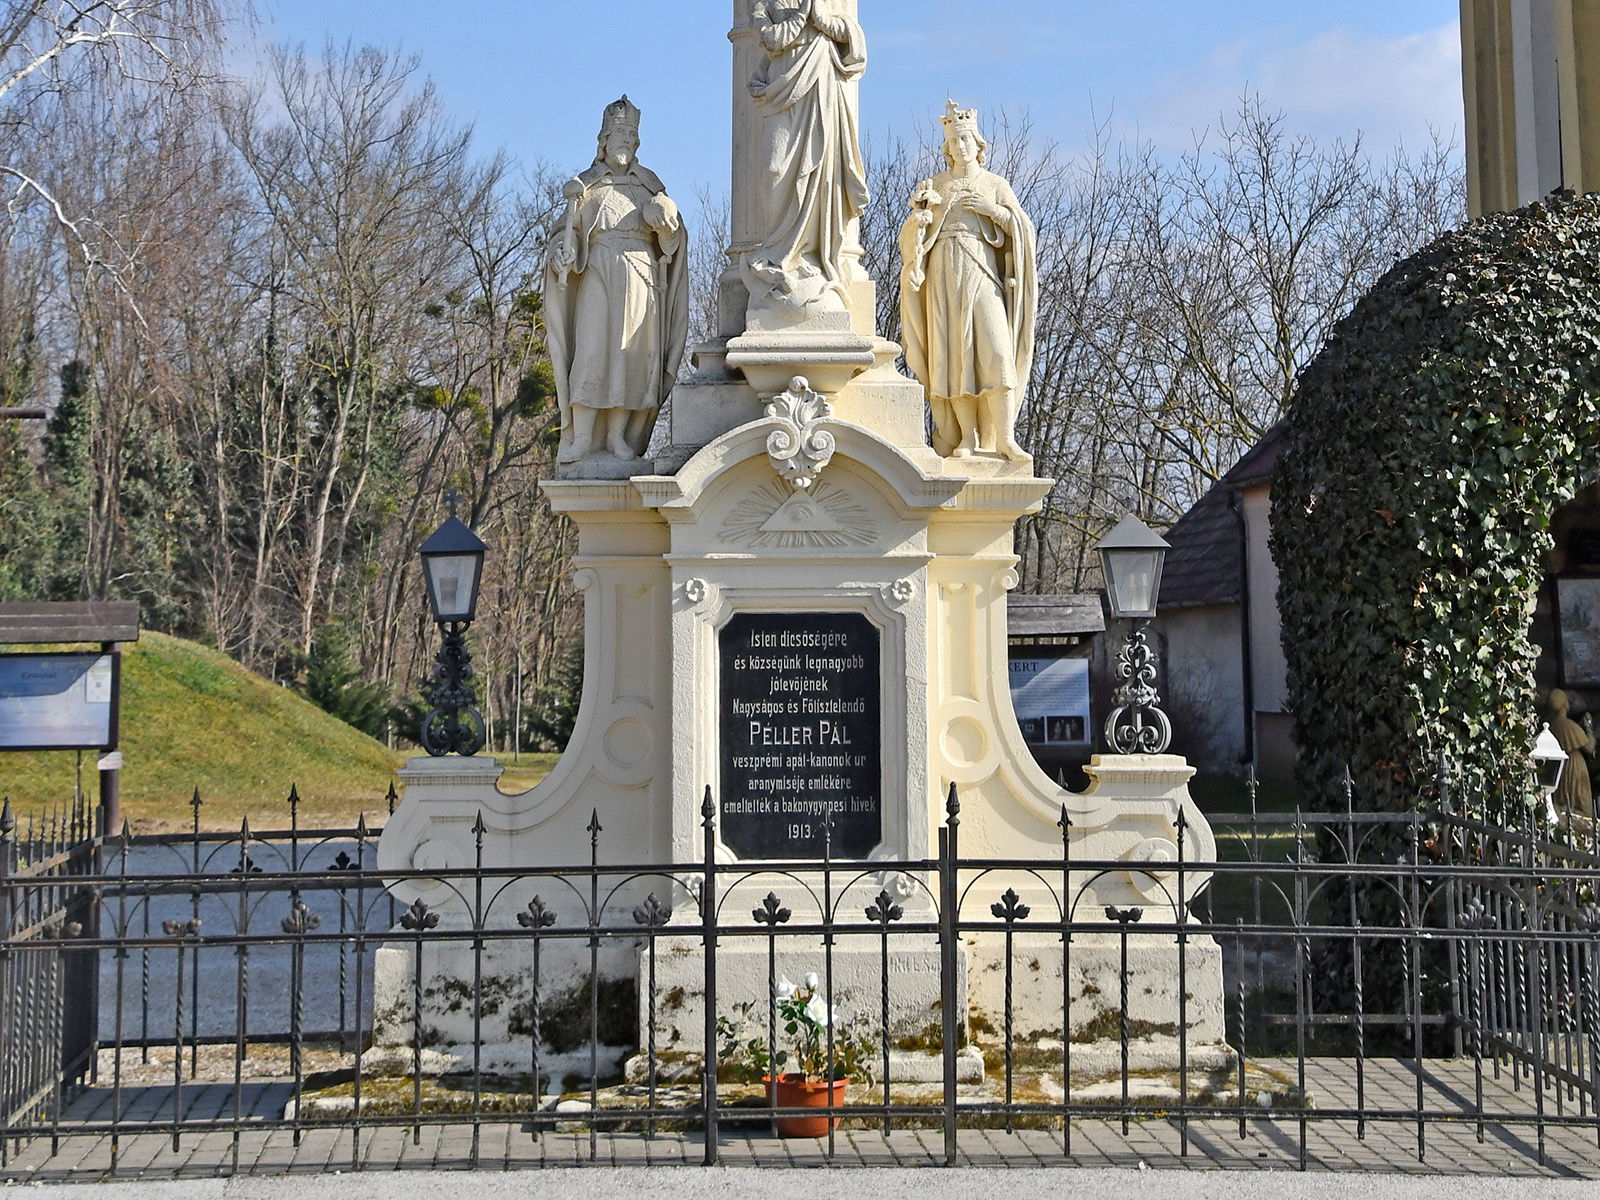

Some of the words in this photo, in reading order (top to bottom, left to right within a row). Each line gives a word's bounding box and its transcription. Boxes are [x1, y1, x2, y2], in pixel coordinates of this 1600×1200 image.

[750, 630, 777, 647] Isten
[734, 654, 746, 670] és
[749, 654, 801, 673] községünk
[805, 654, 864, 673] legnagyobb
[732, 698, 784, 718] Nagyságos
[787, 699, 799, 713] és
[749, 720, 813, 746] PÉLLER
[819, 720, 852, 745] PÁL
[732, 752, 783, 772] veszprémi
[748, 774, 805, 794] aranymiséje
[808, 773, 852, 790] emlékére
[774, 801, 780, 813] a
[788, 823, 815, 839] 1913.
